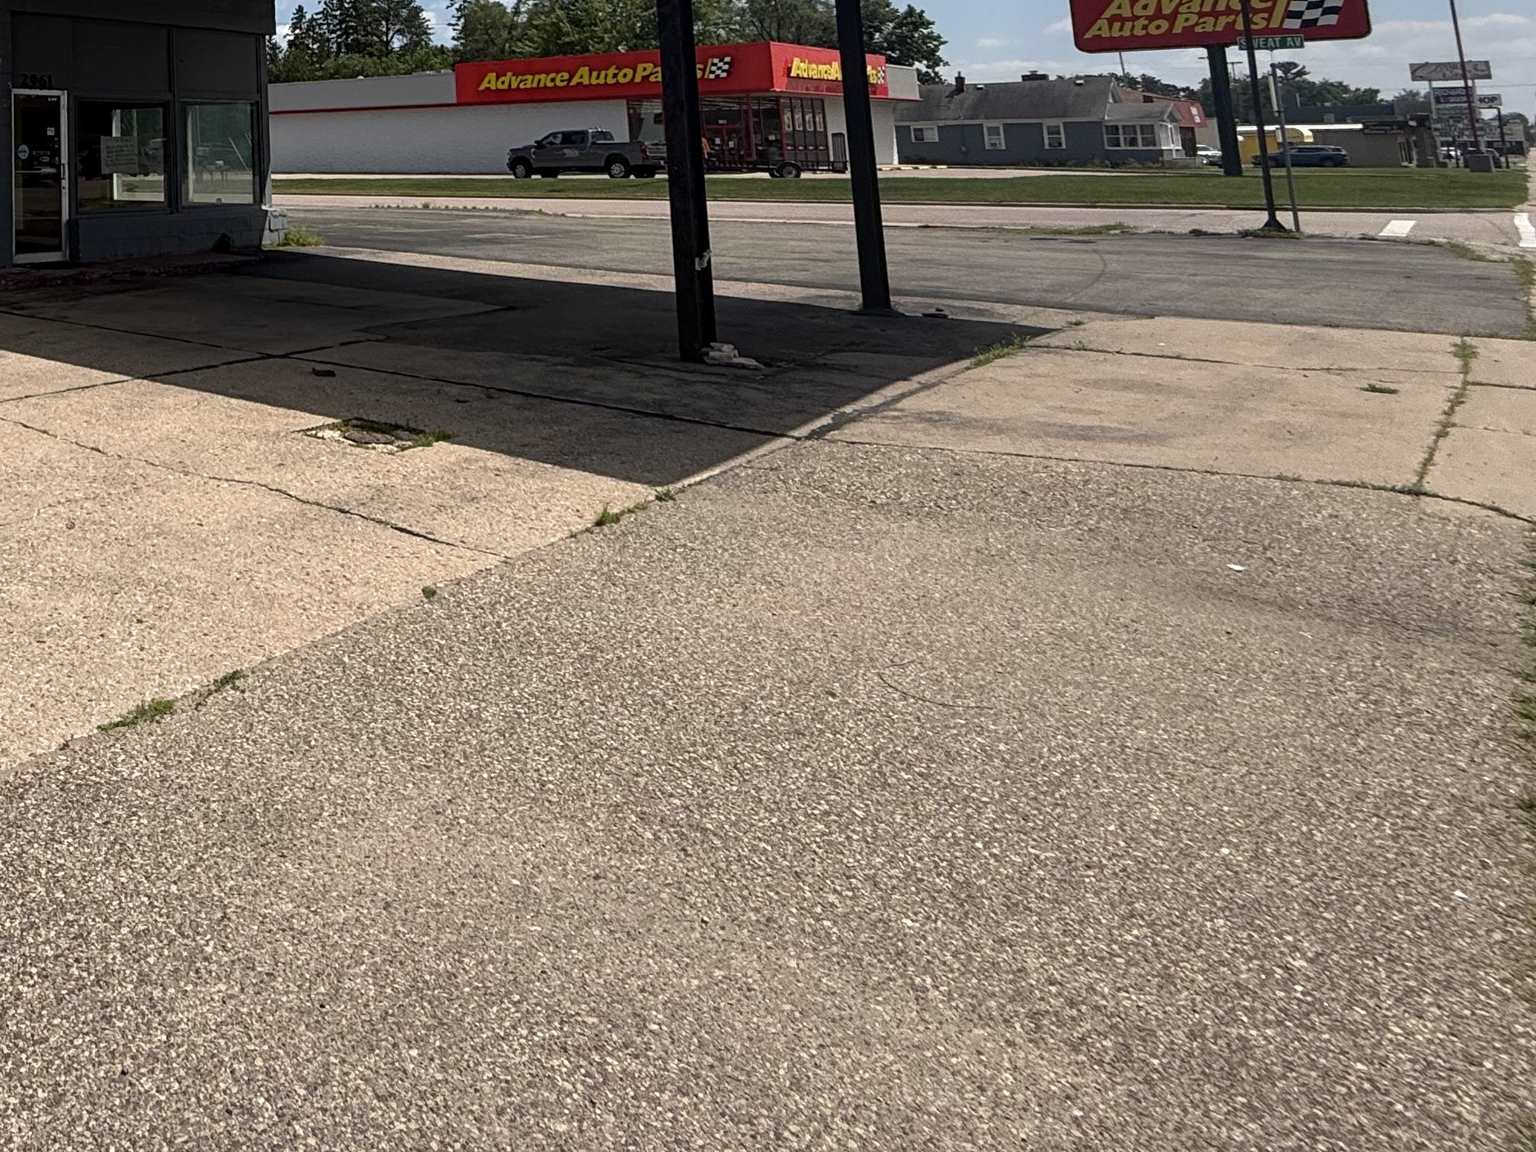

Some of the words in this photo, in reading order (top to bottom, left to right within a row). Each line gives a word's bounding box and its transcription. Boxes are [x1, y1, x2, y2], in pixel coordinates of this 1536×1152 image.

[1083, 17, 1169, 39] Auto
[1171, 12, 1269, 34] Parts
[478, 70, 569, 90] Advance
[568, 64, 635, 86] Auto
[633, 62, 705, 84] Pas
